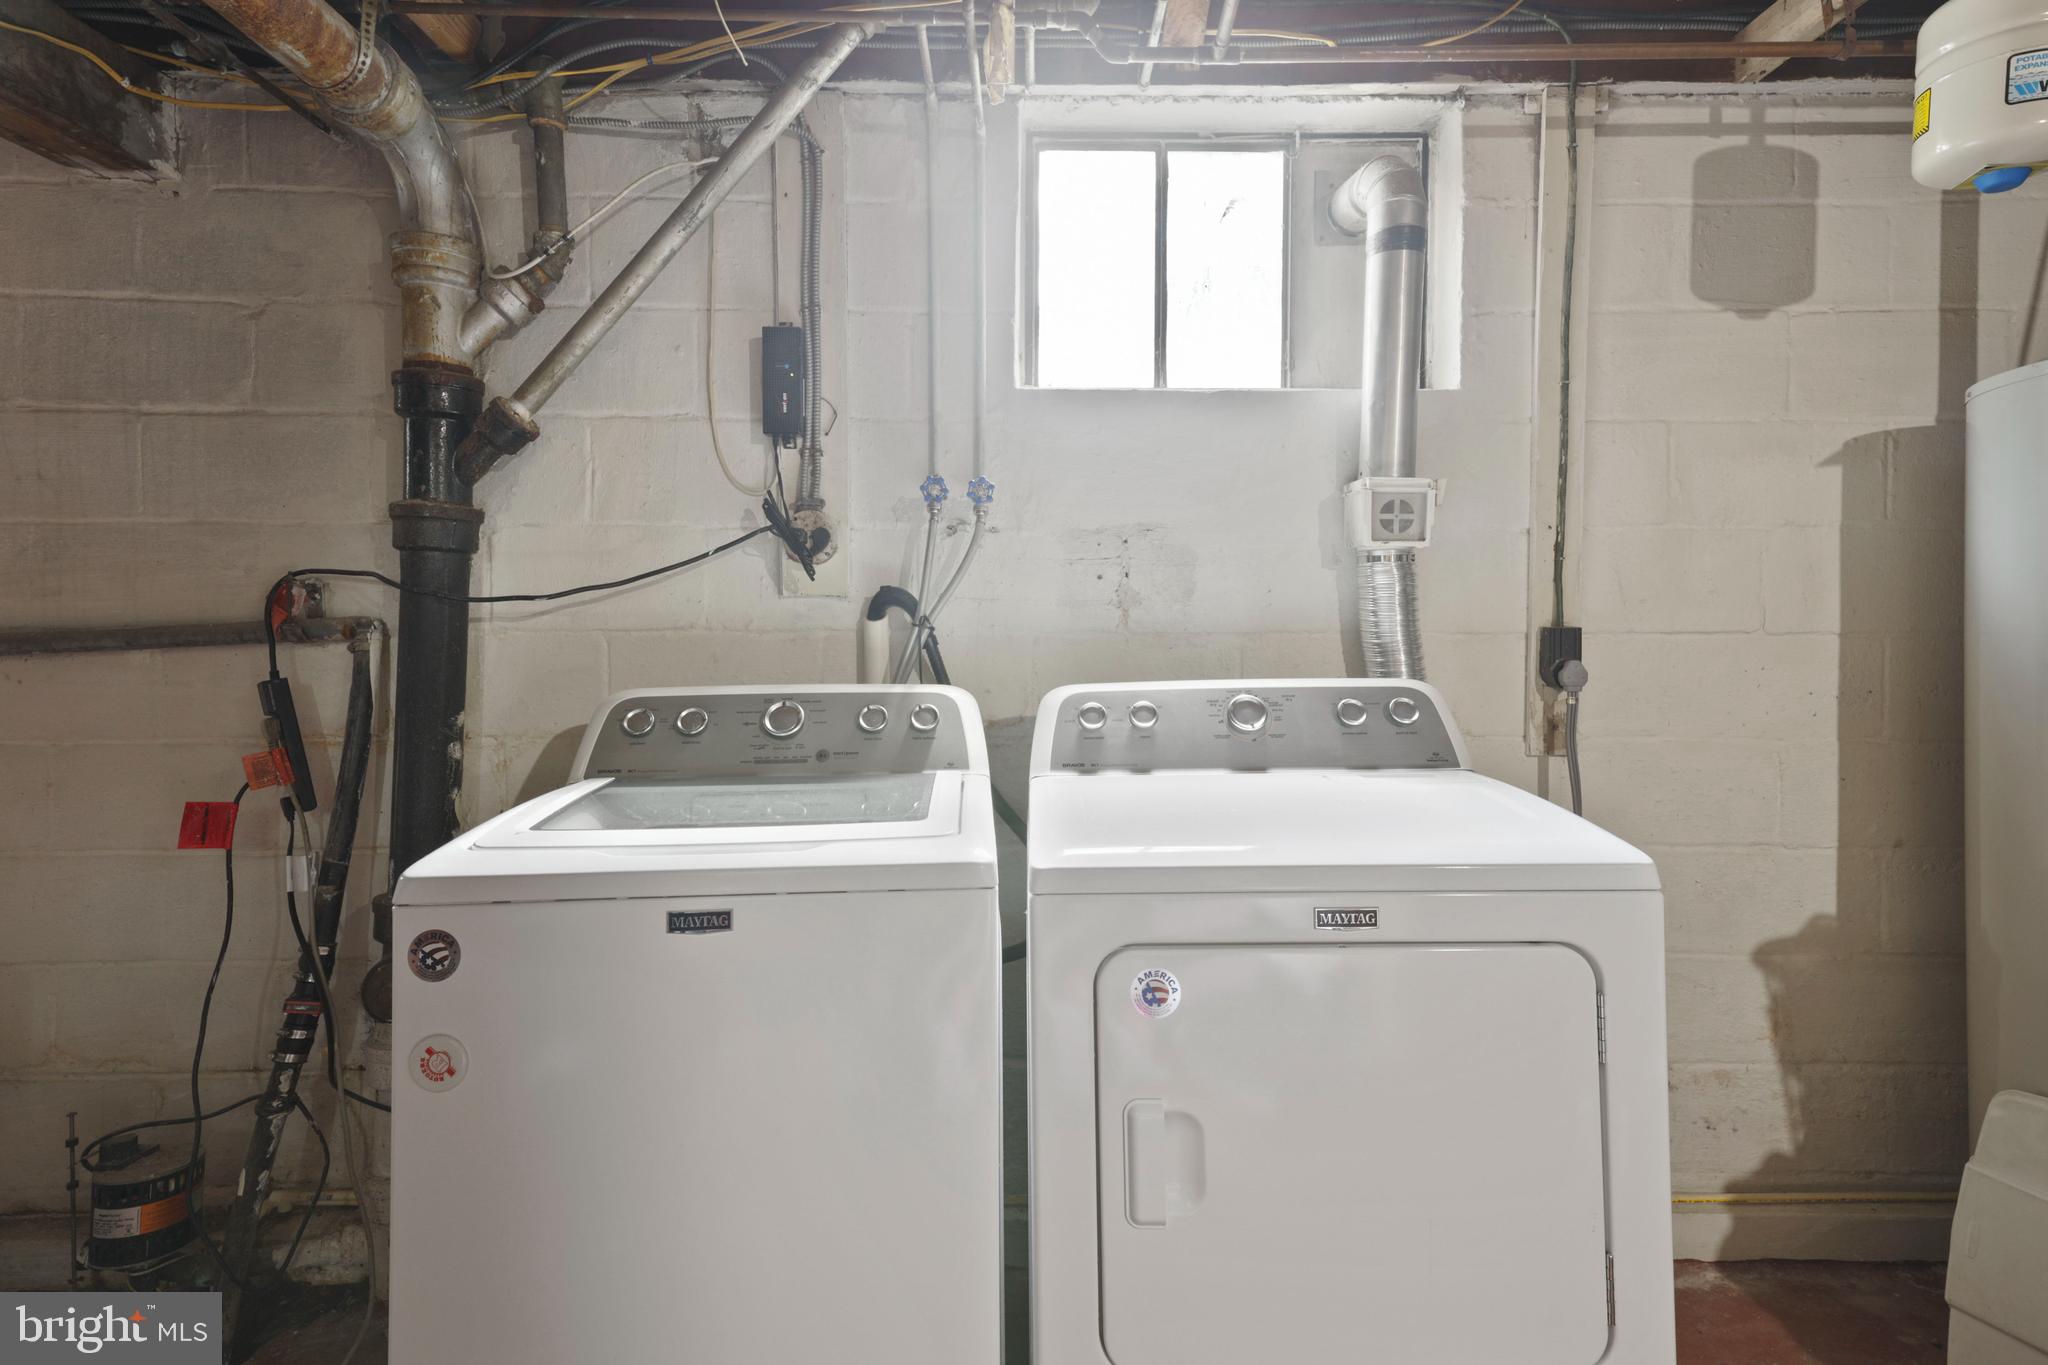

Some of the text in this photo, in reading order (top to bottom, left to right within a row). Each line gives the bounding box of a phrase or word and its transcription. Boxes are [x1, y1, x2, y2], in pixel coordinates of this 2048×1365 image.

[2015, 60, 2048, 71] EXPAN
[671, 915, 729, 928] MAYTAG
[1320, 912, 1376, 925] MAYTAG
[410, 932, 455, 956] AMERICA
[1137, 970, 1178, 994] AMERICA
